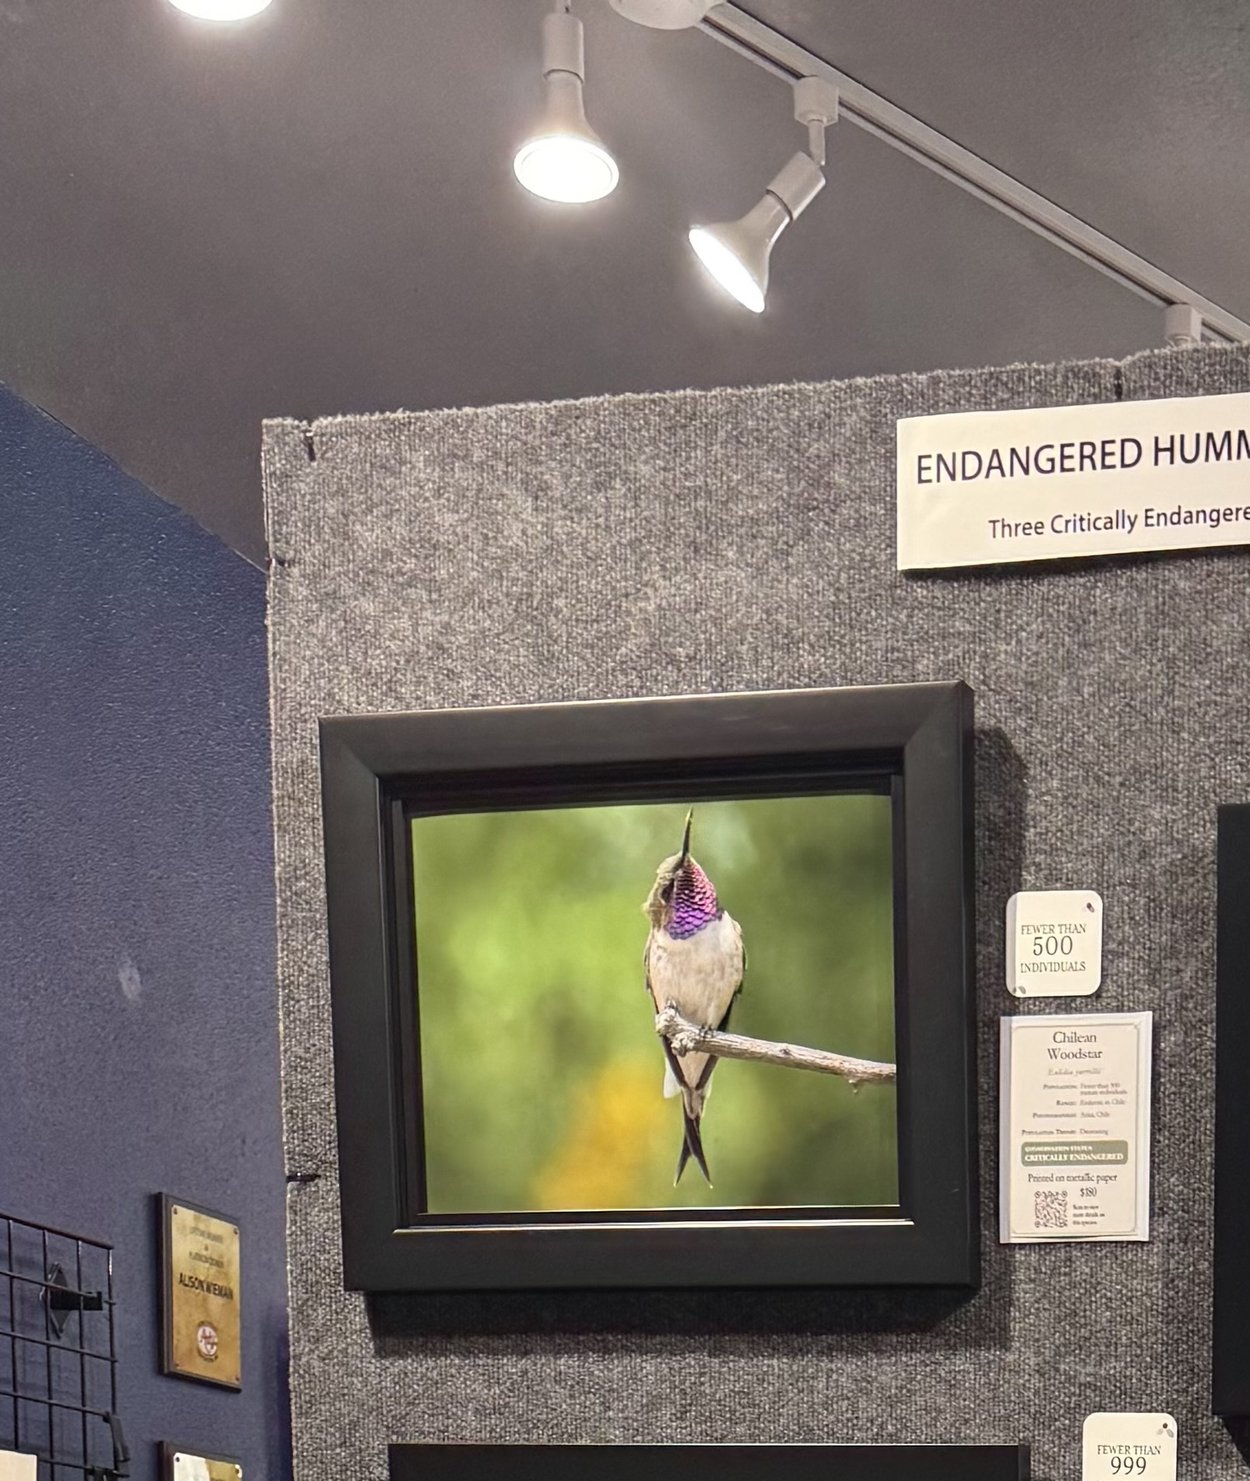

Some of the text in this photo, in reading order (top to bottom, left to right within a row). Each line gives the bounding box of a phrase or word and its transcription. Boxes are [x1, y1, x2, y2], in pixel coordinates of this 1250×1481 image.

[917, 437, 1142, 484] ENDANGERED
[988, 517, 1044, 538] Three
[1050, 509, 1137, 534] Critically
[1020, 923, 1086, 935] FEWER THAN
[1032, 935, 1072, 956] 500
[1020, 960, 1085, 973] INDIVIDUALS
[1052, 1030, 1096, 1043] Chilean
[1047, 1047, 1102, 1059] Woodstar
[1097, 1444, 1161, 1456] FEWER THAN
[1110, 1455, 1146, 1475] 999
